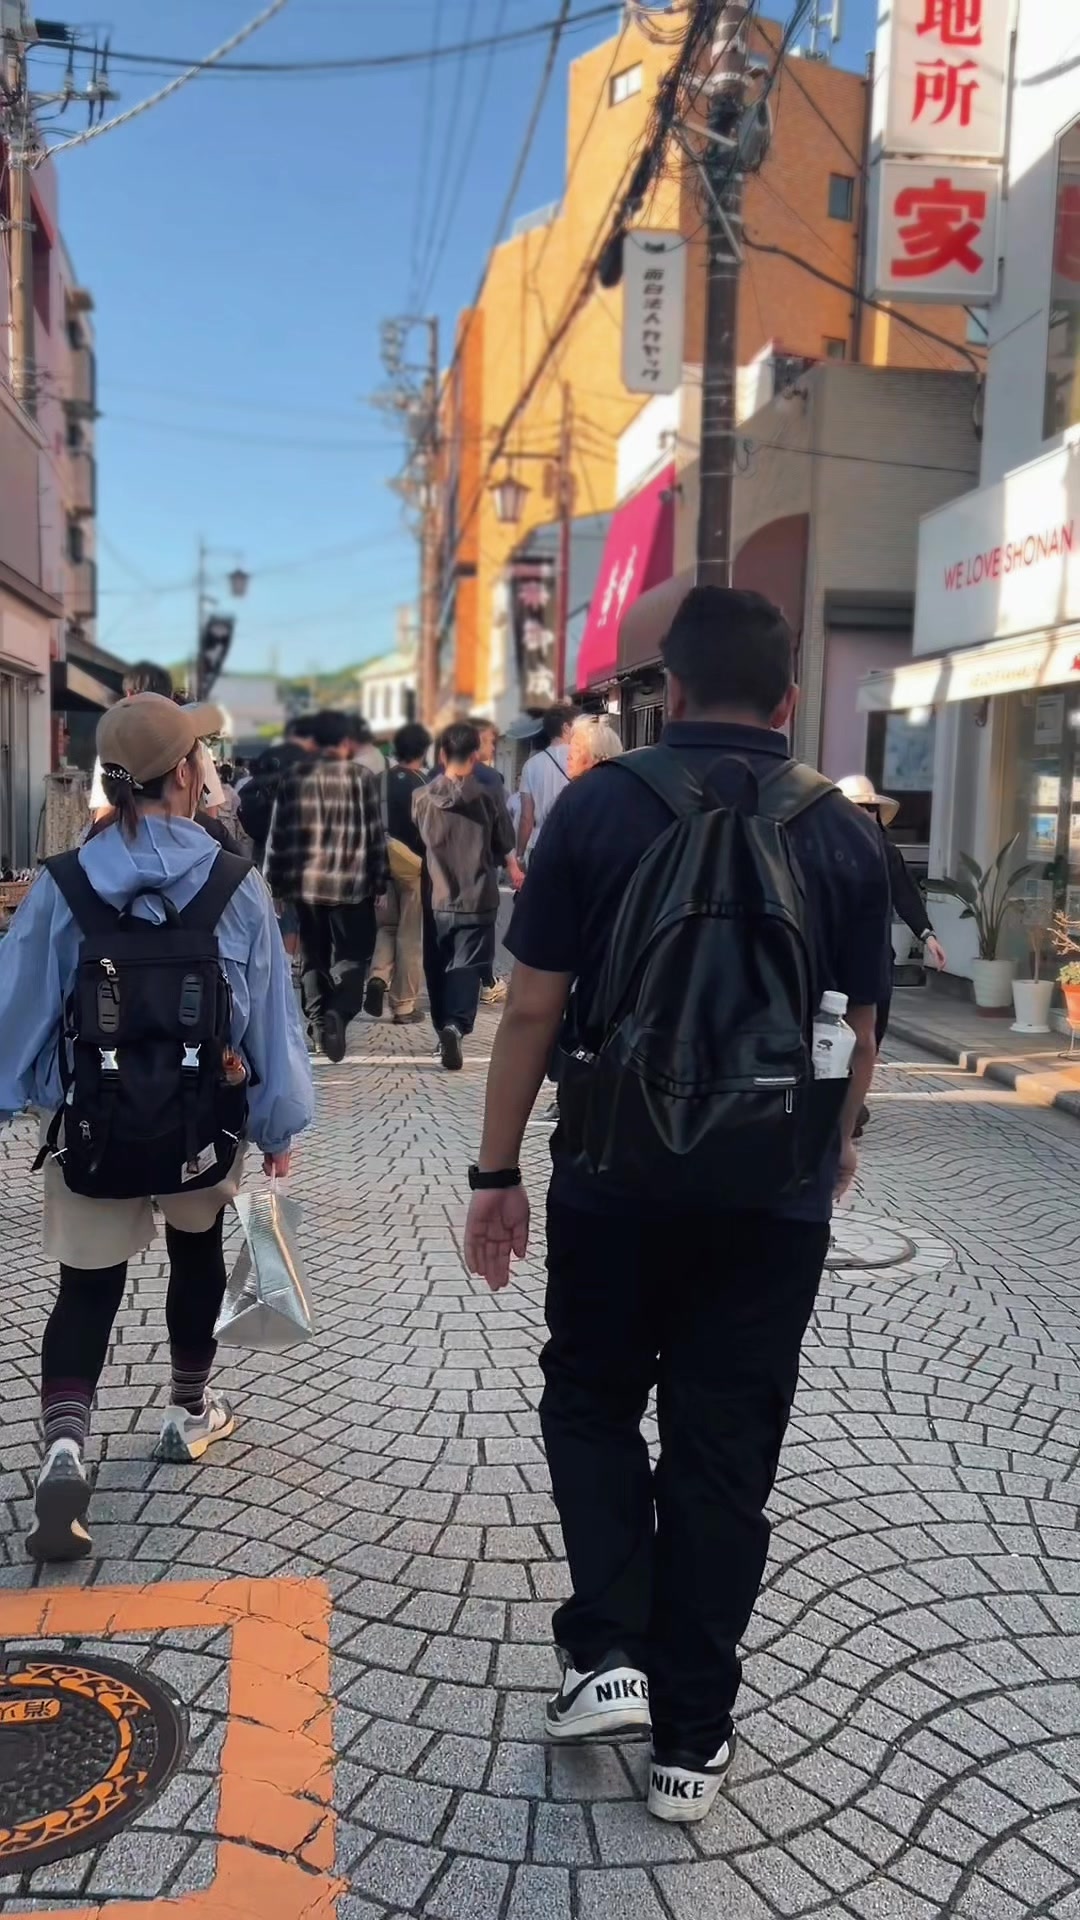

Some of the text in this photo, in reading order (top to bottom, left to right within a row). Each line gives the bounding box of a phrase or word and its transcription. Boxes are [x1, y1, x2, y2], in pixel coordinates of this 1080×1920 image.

[911, 0, 982, 127] 地所
[891, 178, 987, 278] 家
[943, 519, 1075, 592] WE LOVE SHONAN
[651, 1769, 705, 1799] NIKE
